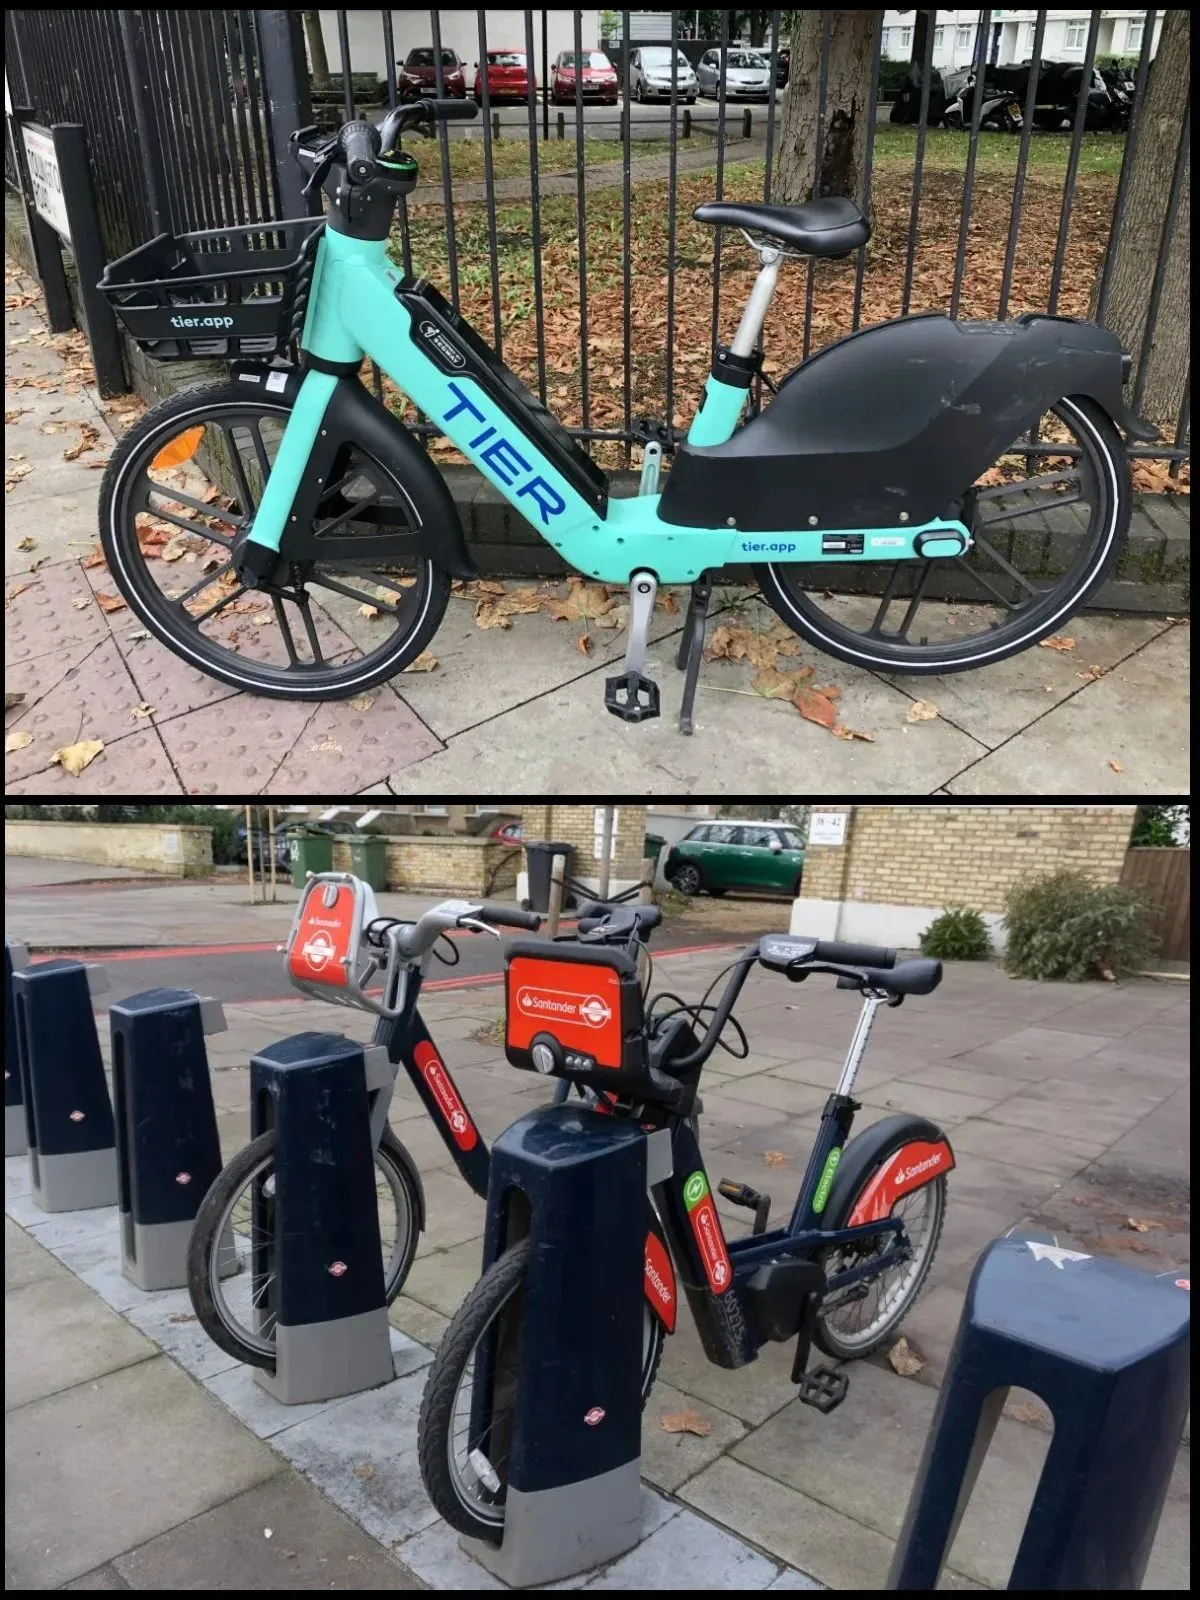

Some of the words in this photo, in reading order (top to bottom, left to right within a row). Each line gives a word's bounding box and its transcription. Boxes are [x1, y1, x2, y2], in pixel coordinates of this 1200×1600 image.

[170, 315, 234, 328] tier.app
[433, 337, 459, 363] SEGWAY
[442, 381, 566, 525] TIER
[741, 541, 796, 553] tier.app
[532, 996, 576, 1014] Santander
[433, 1073, 455, 1110] Santander
[905, 1152, 943, 1179] Santander
[645, 1257, 672, 1304] Santander
